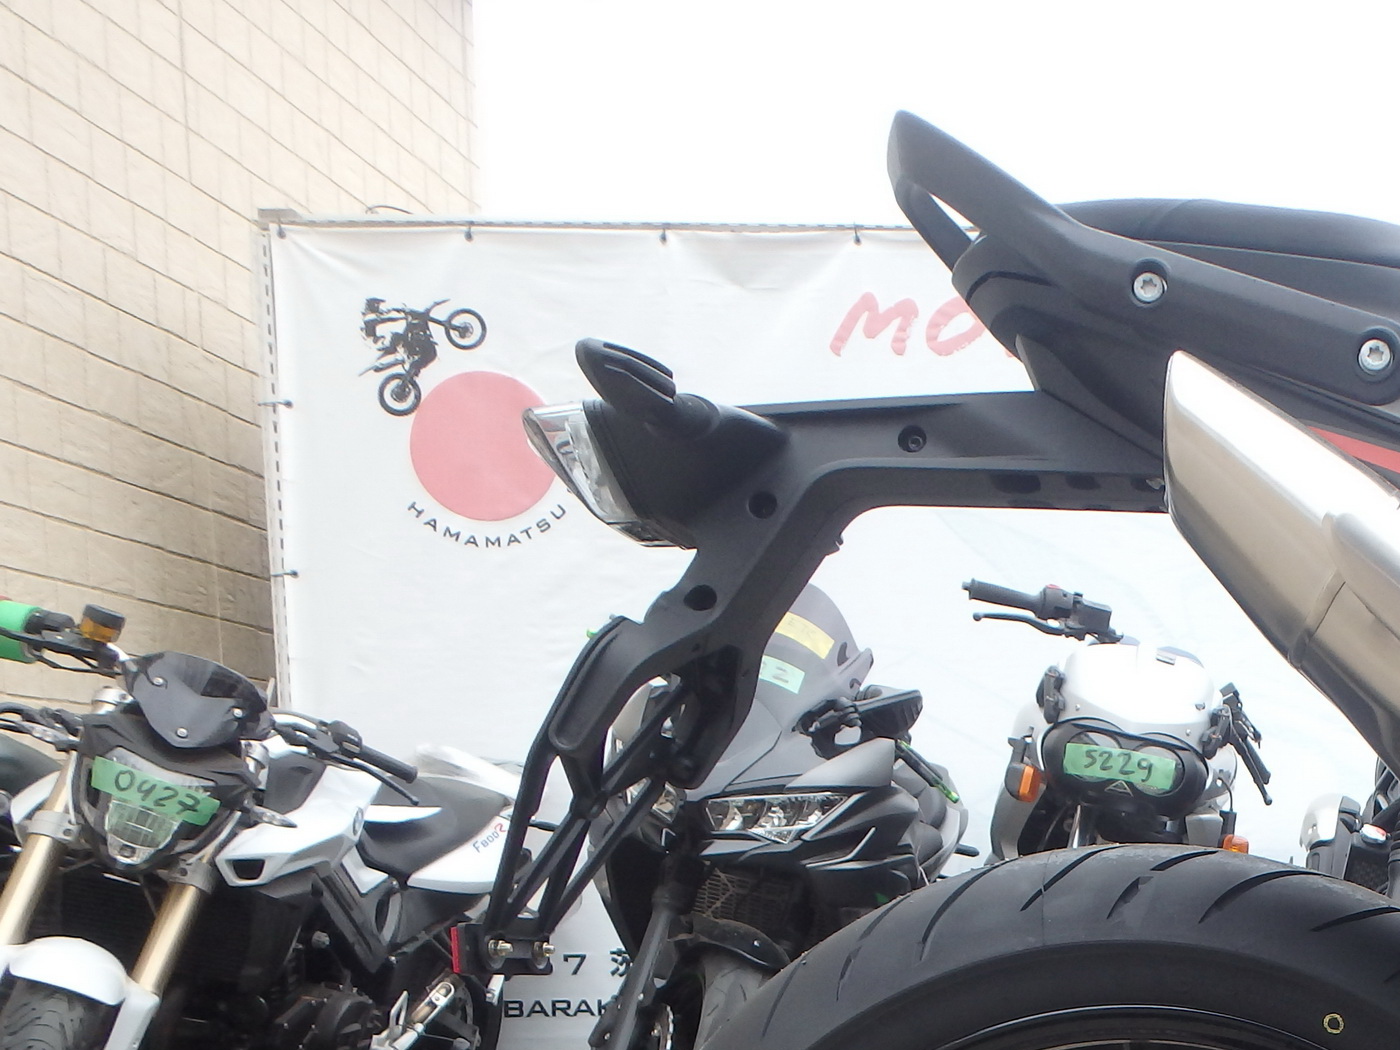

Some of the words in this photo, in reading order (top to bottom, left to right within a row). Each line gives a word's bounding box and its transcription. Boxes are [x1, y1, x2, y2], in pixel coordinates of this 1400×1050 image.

[408, 501, 566, 548] HAMAMATSU
[1084, 749, 1153, 782] 5229
[114, 769, 201, 815] 0427
